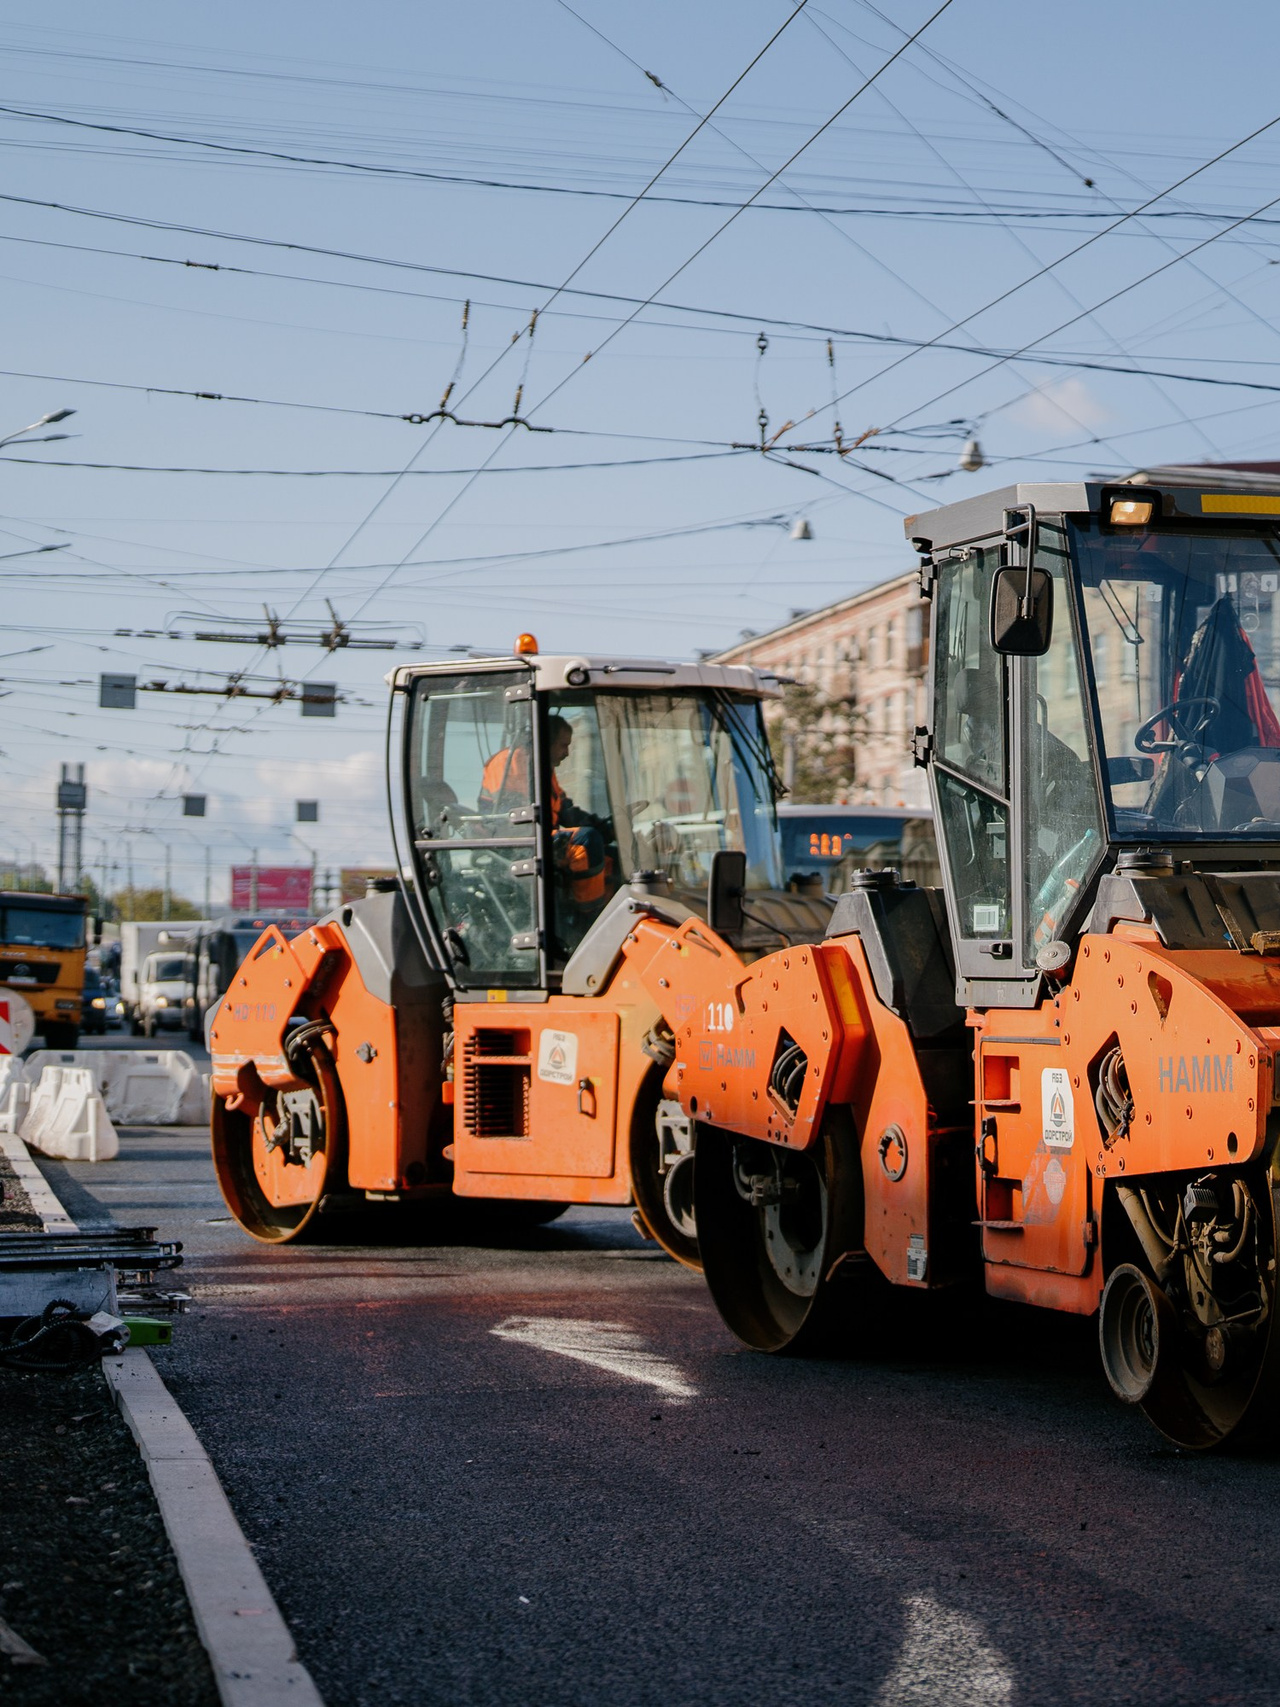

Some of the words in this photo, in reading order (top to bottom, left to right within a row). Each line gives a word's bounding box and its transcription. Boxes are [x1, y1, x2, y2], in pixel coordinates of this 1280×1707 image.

[707, 1002, 733, 1031] 110
[716, 1047, 755, 1068] HAMM
[1159, 1054, 1233, 1092] HAMM
